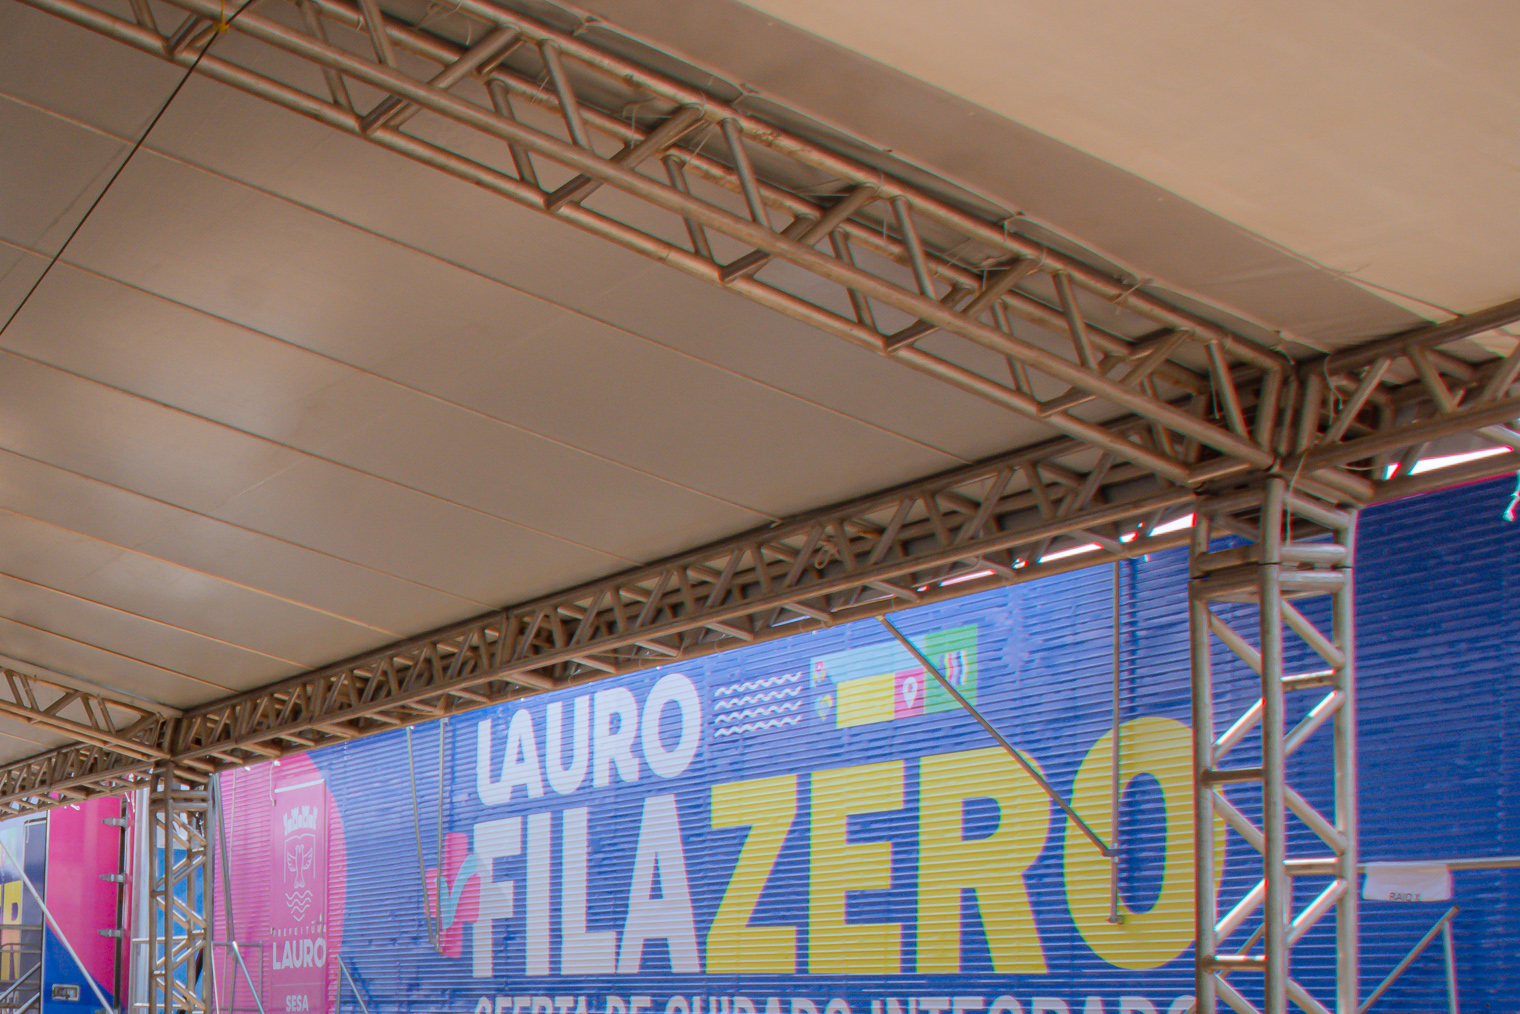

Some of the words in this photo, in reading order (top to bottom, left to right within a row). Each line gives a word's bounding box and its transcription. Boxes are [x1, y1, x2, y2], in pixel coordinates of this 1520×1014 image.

[476, 673, 702, 806] LAURO
[472, 793, 702, 978] FILA
[706, 716, 1226, 975] ZERO
[1389, 892, 1413, 902] RAIO
[272, 937, 327, 970] LAURO
[285, 994, 309, 1012] SESA
